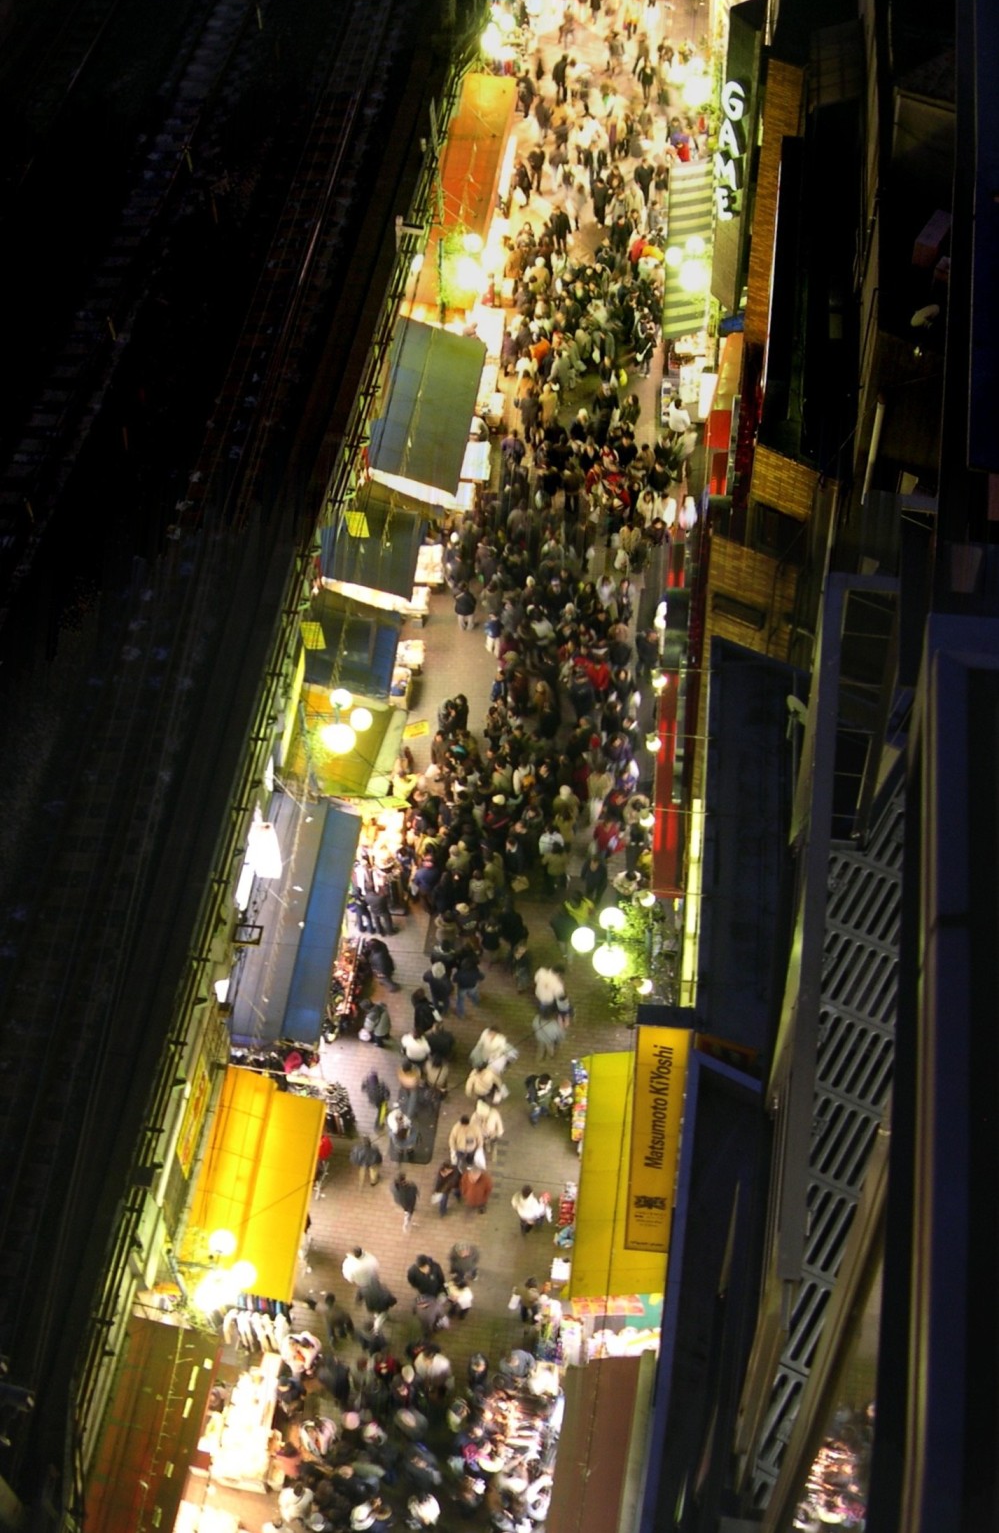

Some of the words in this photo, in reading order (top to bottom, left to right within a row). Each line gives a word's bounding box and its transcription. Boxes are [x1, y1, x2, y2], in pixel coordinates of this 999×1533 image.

[715, 80, 746, 222] GAME
[648, 1044, 675, 1097] KiYoshi
[643, 1097, 668, 1170] Matsumoto
